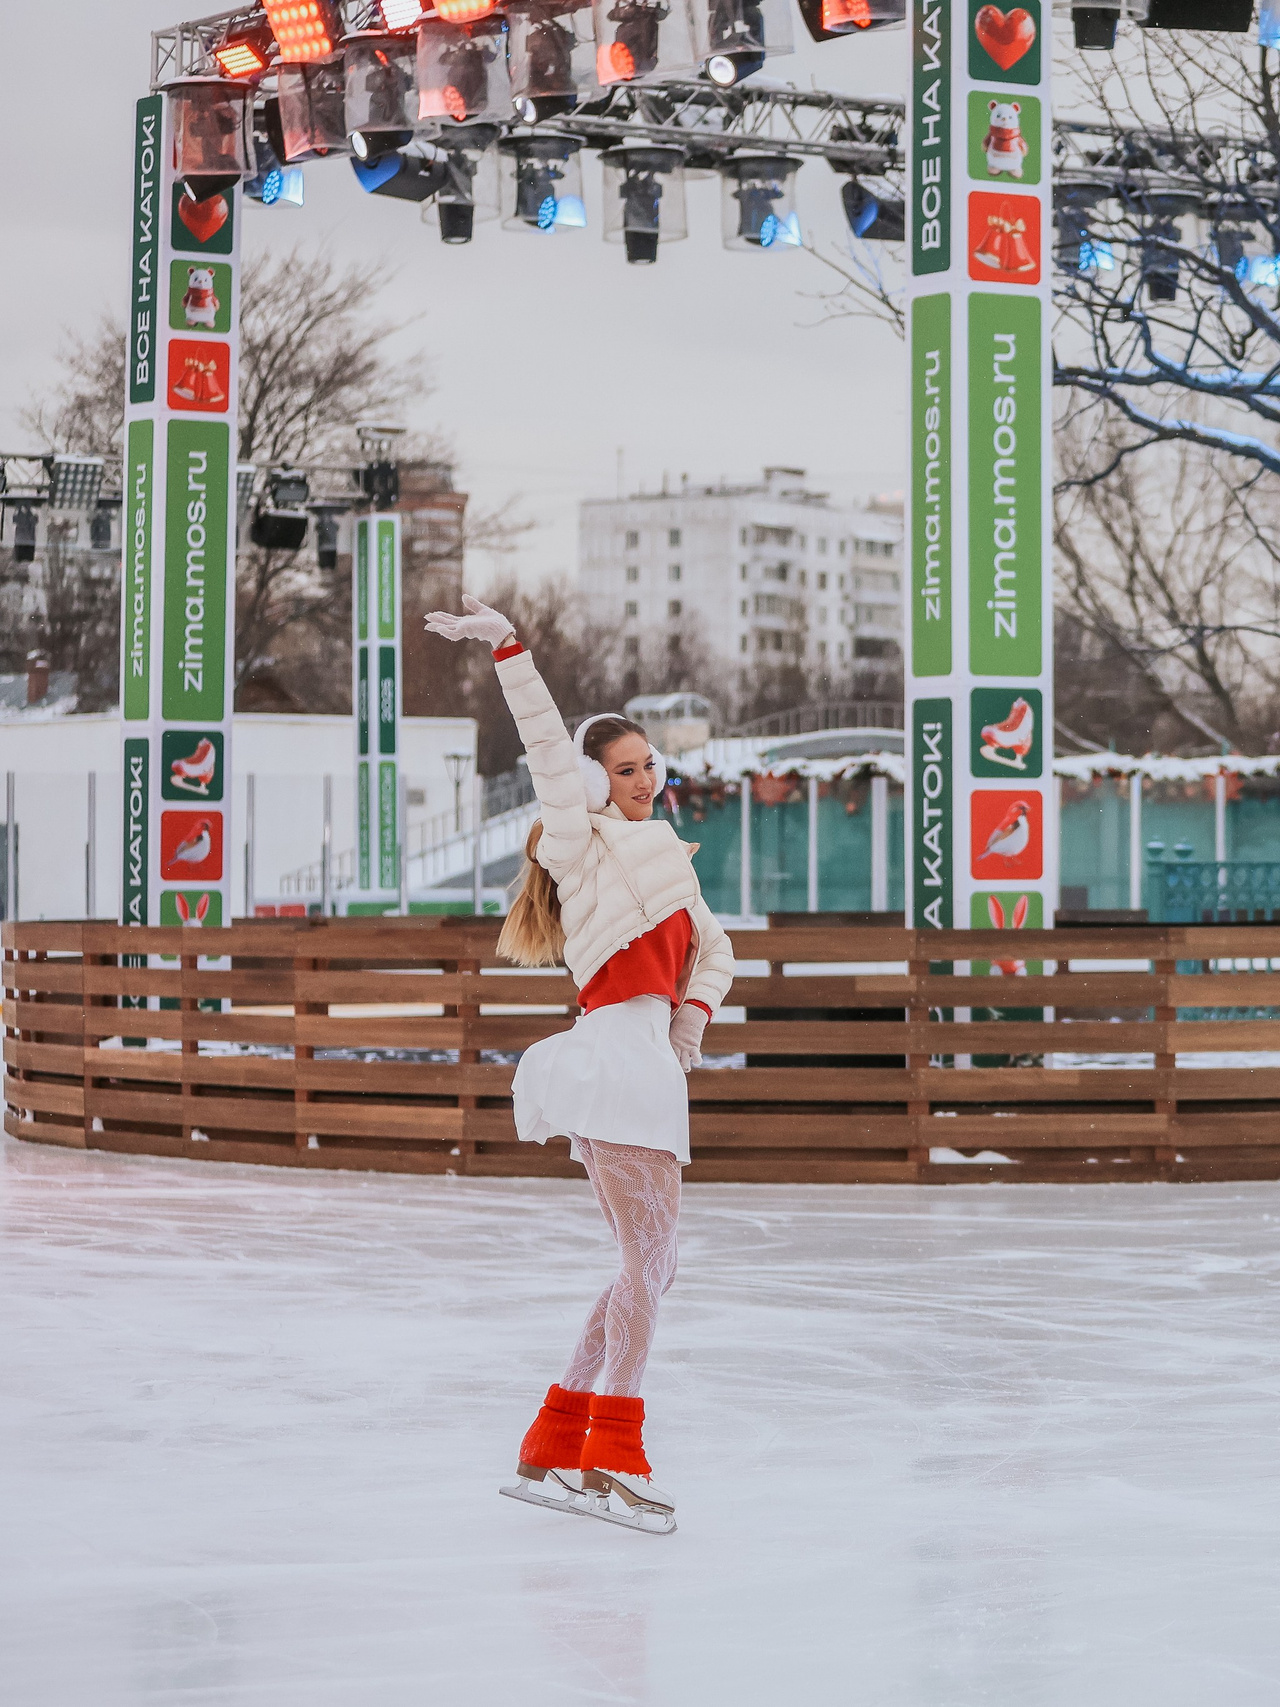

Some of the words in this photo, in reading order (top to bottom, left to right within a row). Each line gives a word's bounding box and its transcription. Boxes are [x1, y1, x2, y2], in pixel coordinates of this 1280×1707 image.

[922, 0, 942, 72] КАТ
[922, 79, 942, 147] НА
[139, 114, 156, 242] КАТОК!
[921, 156, 941, 251] ВСЕ
[138, 248, 152, 303] НА
[136, 310, 150, 385] ВСЕ
[921, 350, 941, 621] zima.mos.ru
[987, 334, 1017, 638] zima.mos.ru
[131, 463, 147, 678] zima.mos.ru
[179, 451, 207, 692] zima.mos.ru
[129, 756, 143, 887] КАТОК!
[922, 723, 943, 887] КАТОК!
